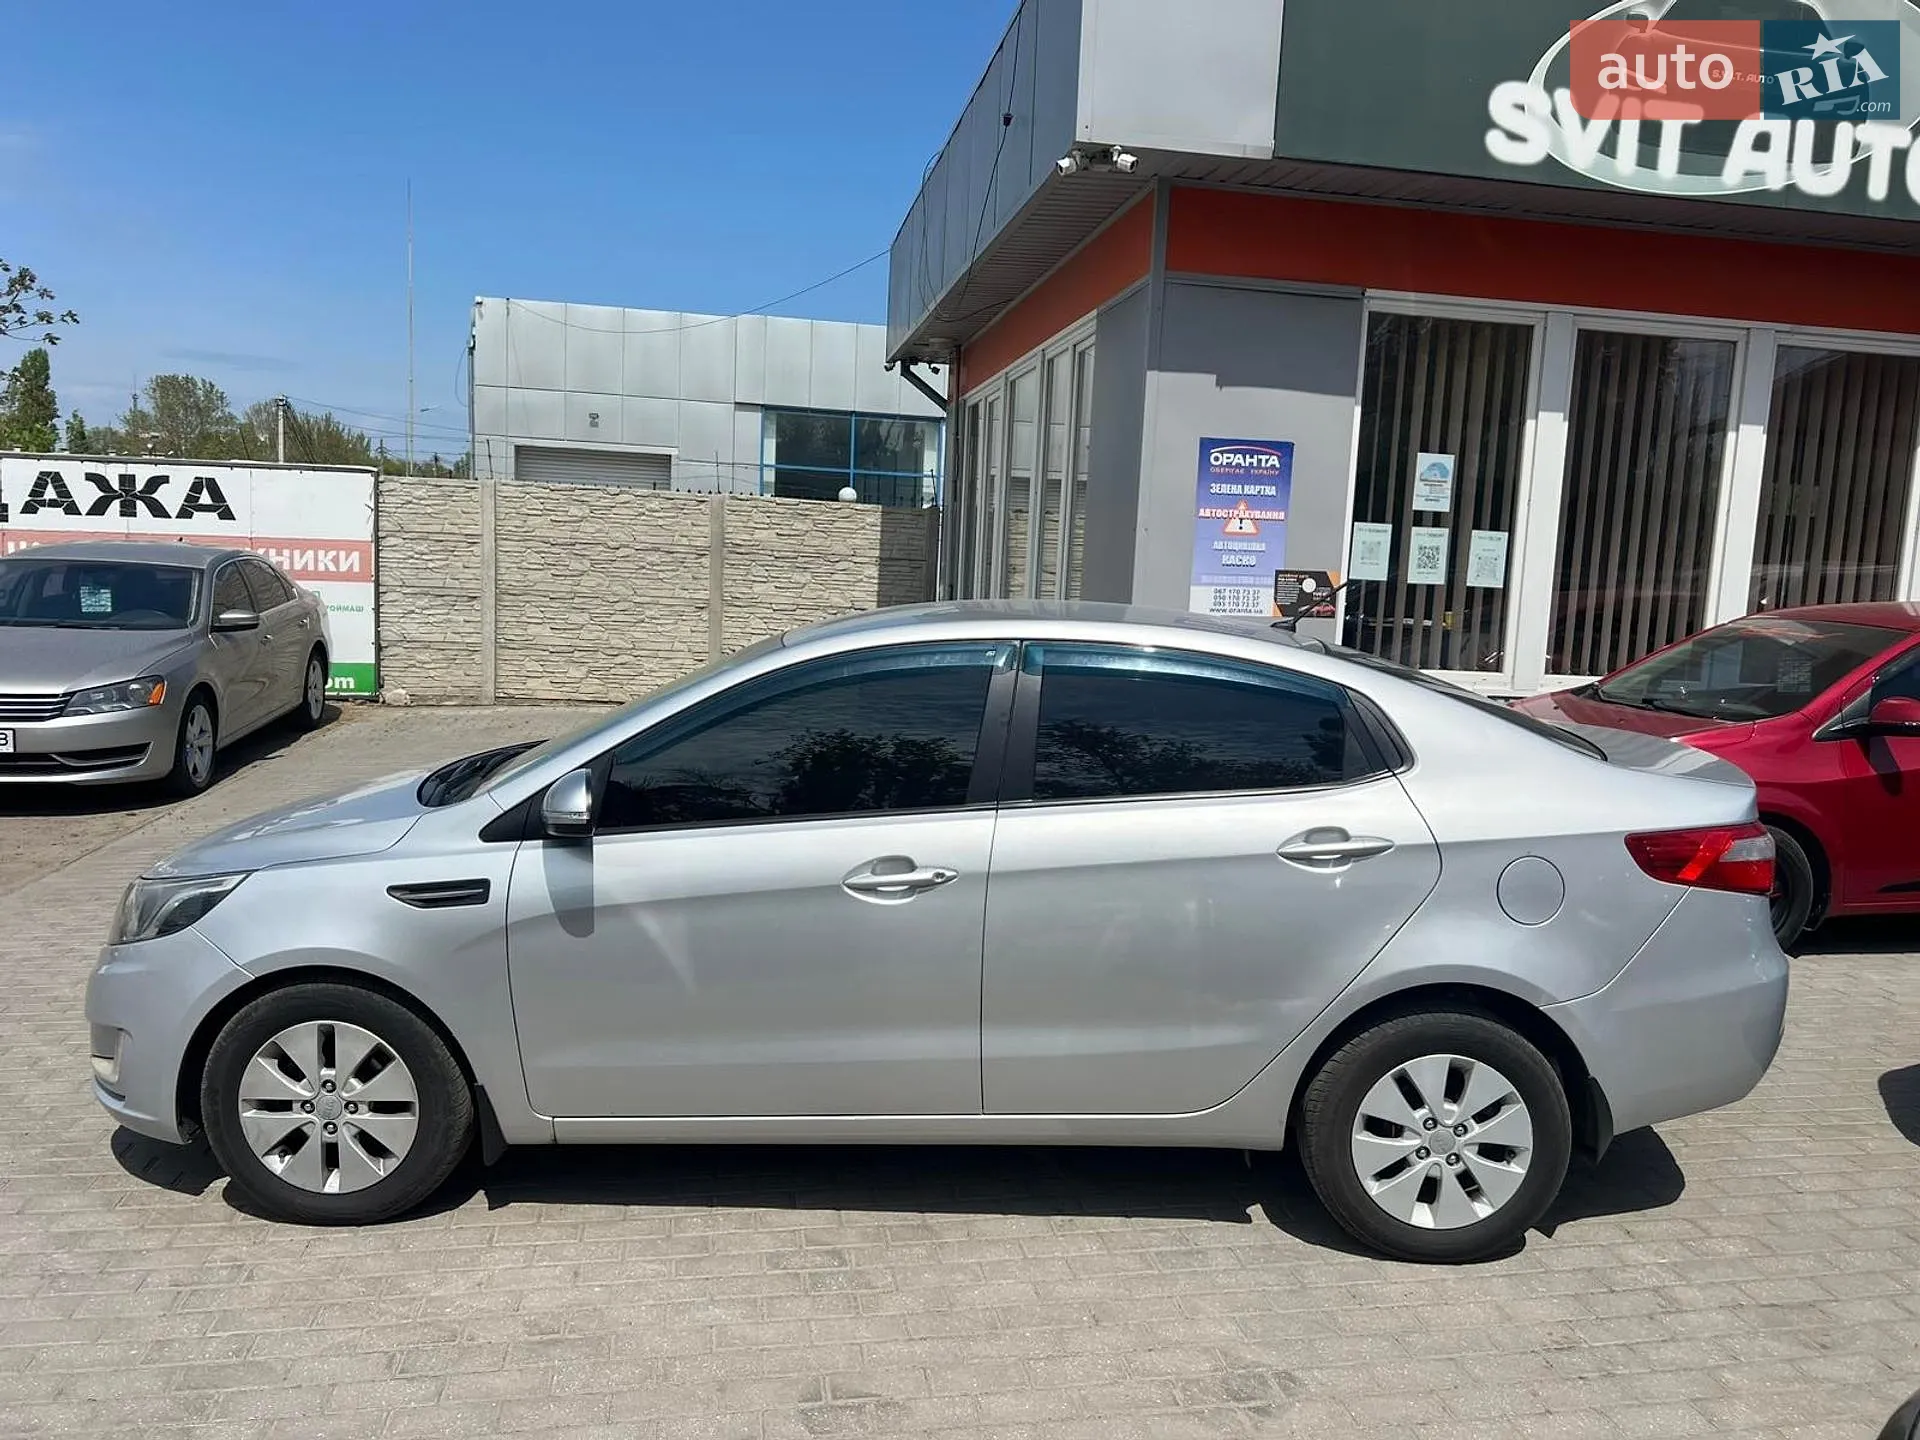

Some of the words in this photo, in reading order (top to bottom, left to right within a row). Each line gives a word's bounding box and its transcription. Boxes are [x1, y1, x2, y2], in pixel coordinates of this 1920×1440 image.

[1485, 80, 1704, 181] SVIT
[1721, 113, 1920, 205] AUT
[1209, 453, 1280, 468] ОРАНТА
[0, 471, 237, 522] АЖА
[1209, 482, 1243, 496] ЗЕЛЕНА
[1243, 484, 1277, 498] КАРТКА
[256, 547, 360, 573] НИКИ
[327, 603, 364, 613] ОЙМАШ
